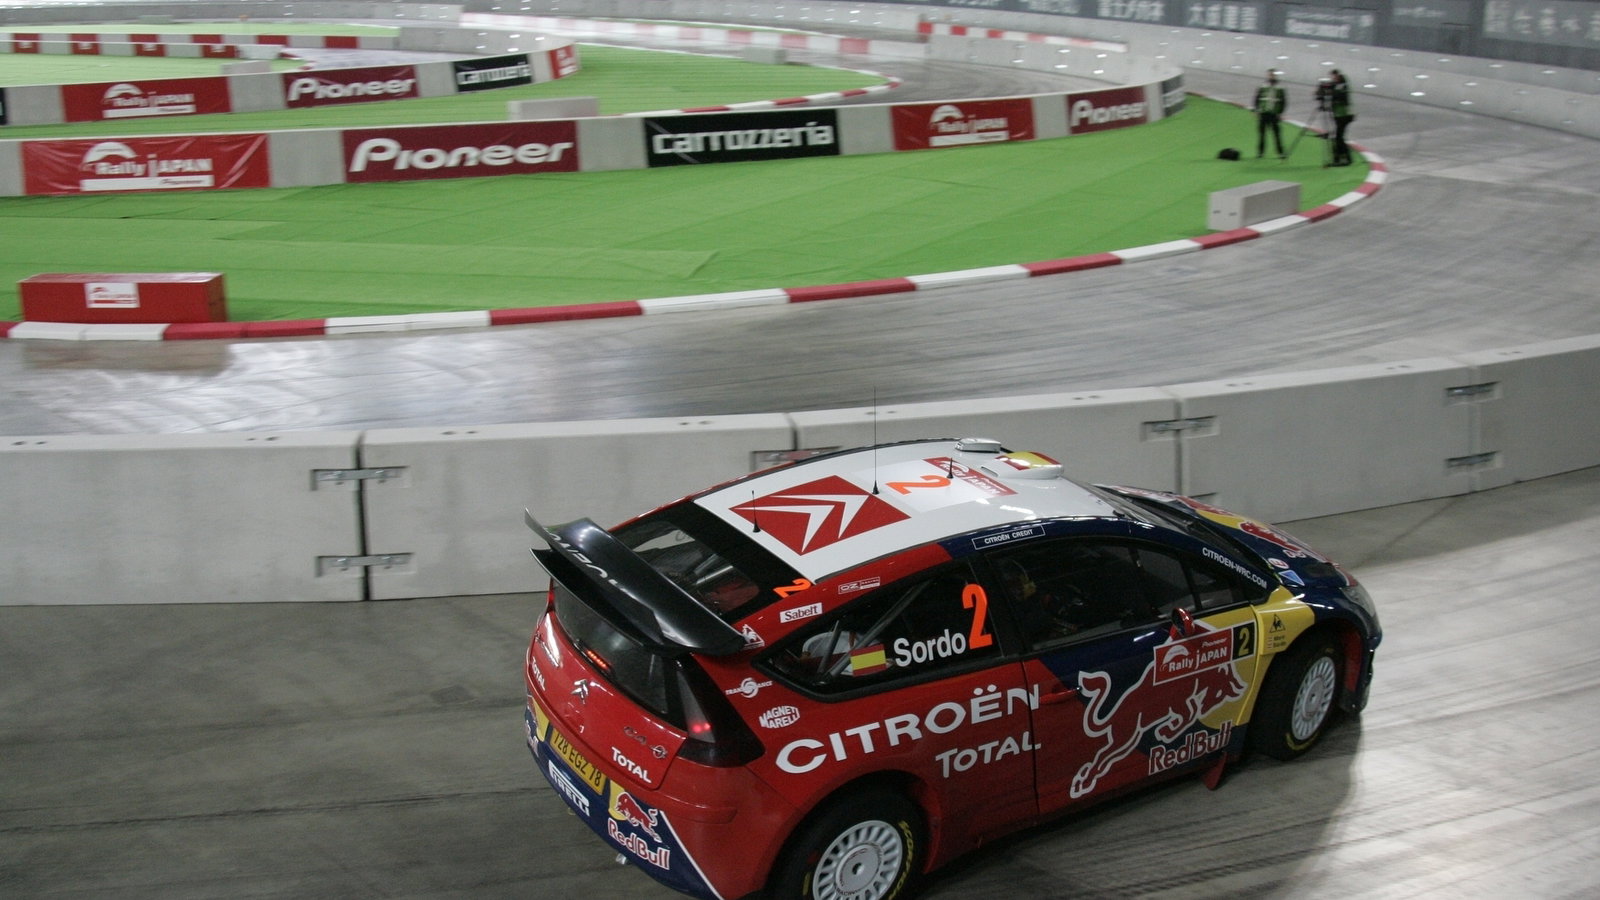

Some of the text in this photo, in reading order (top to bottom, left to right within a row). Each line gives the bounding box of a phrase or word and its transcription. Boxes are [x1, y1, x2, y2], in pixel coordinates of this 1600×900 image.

[288, 77, 416, 101] Pioneer
[1070, 99, 1147, 127] Pioneer
[652, 121, 835, 154] carrozzeria
[95, 161, 145, 177] Rally
[350, 137, 574, 173] Pioneer
[885, 474, 952, 496] 2
[984, 528, 1034, 545] CITROËN CREDIT
[1202, 547, 1267, 589] CITROEN-WRC.COM
[772, 578, 812, 599] 2
[784, 605, 818, 621] Sabelt
[961, 583, 993, 650] 2
[893, 628, 967, 668] Sordo
[1239, 627, 1251, 656] 2
[1168, 656, 1195, 673] Rally
[775, 683, 1040, 774] CITROËN
[611, 746, 653, 784] TOTAL
[935, 731, 1042, 779] TOTAL
[548, 759, 591, 817] PIRELLI
